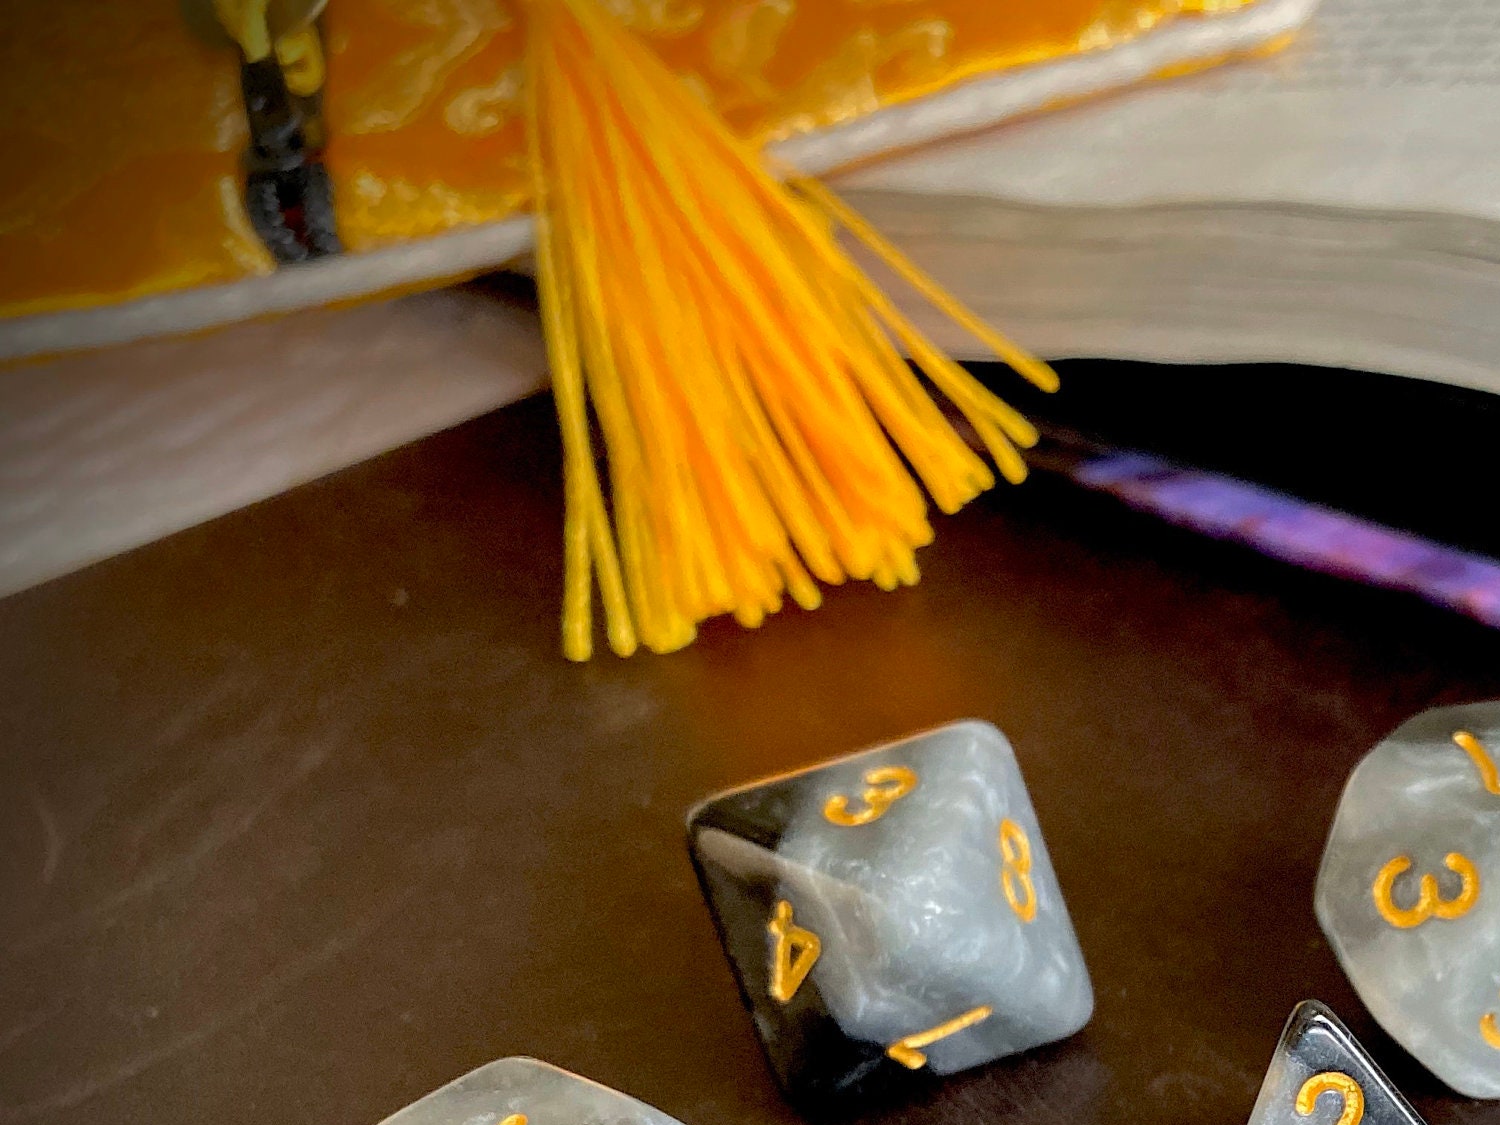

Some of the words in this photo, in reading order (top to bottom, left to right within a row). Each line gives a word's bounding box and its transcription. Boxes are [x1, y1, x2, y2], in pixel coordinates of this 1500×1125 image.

[822, 765, 918, 827] 3
[1000, 818, 1038, 924] 8
[1372, 852, 1480, 929] 3
[768, 900, 822, 1004] 4
